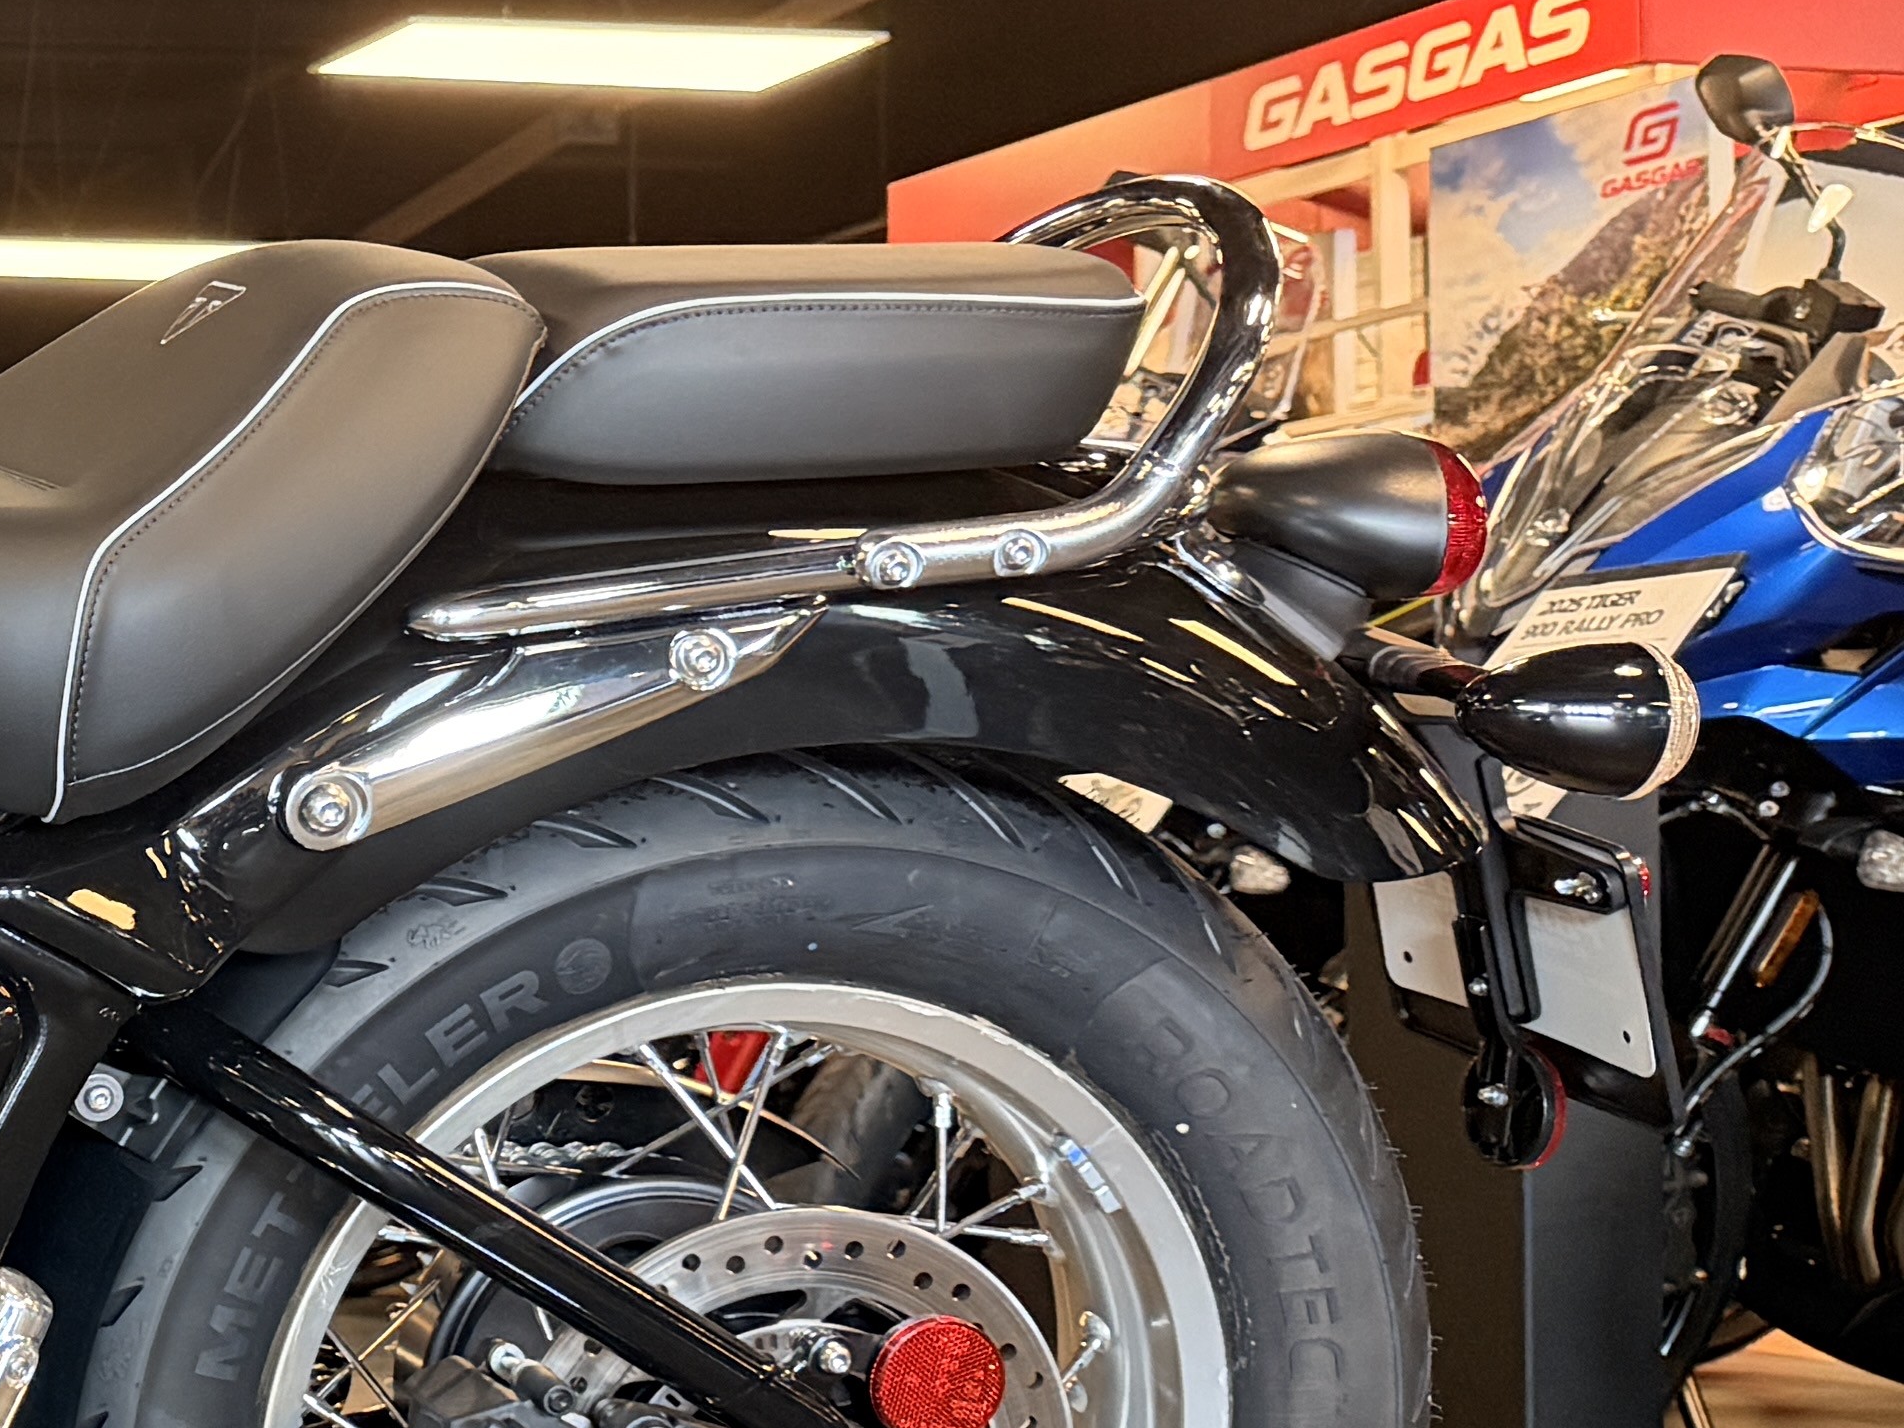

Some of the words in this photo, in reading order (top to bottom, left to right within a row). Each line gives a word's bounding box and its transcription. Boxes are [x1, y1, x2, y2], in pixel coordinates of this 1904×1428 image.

[1585, 590, 1642, 609] TIGER
[1520, 622, 1557, 640] 900
[1557, 614, 1621, 637] RALLY
[1619, 609, 1665, 629] PRO
